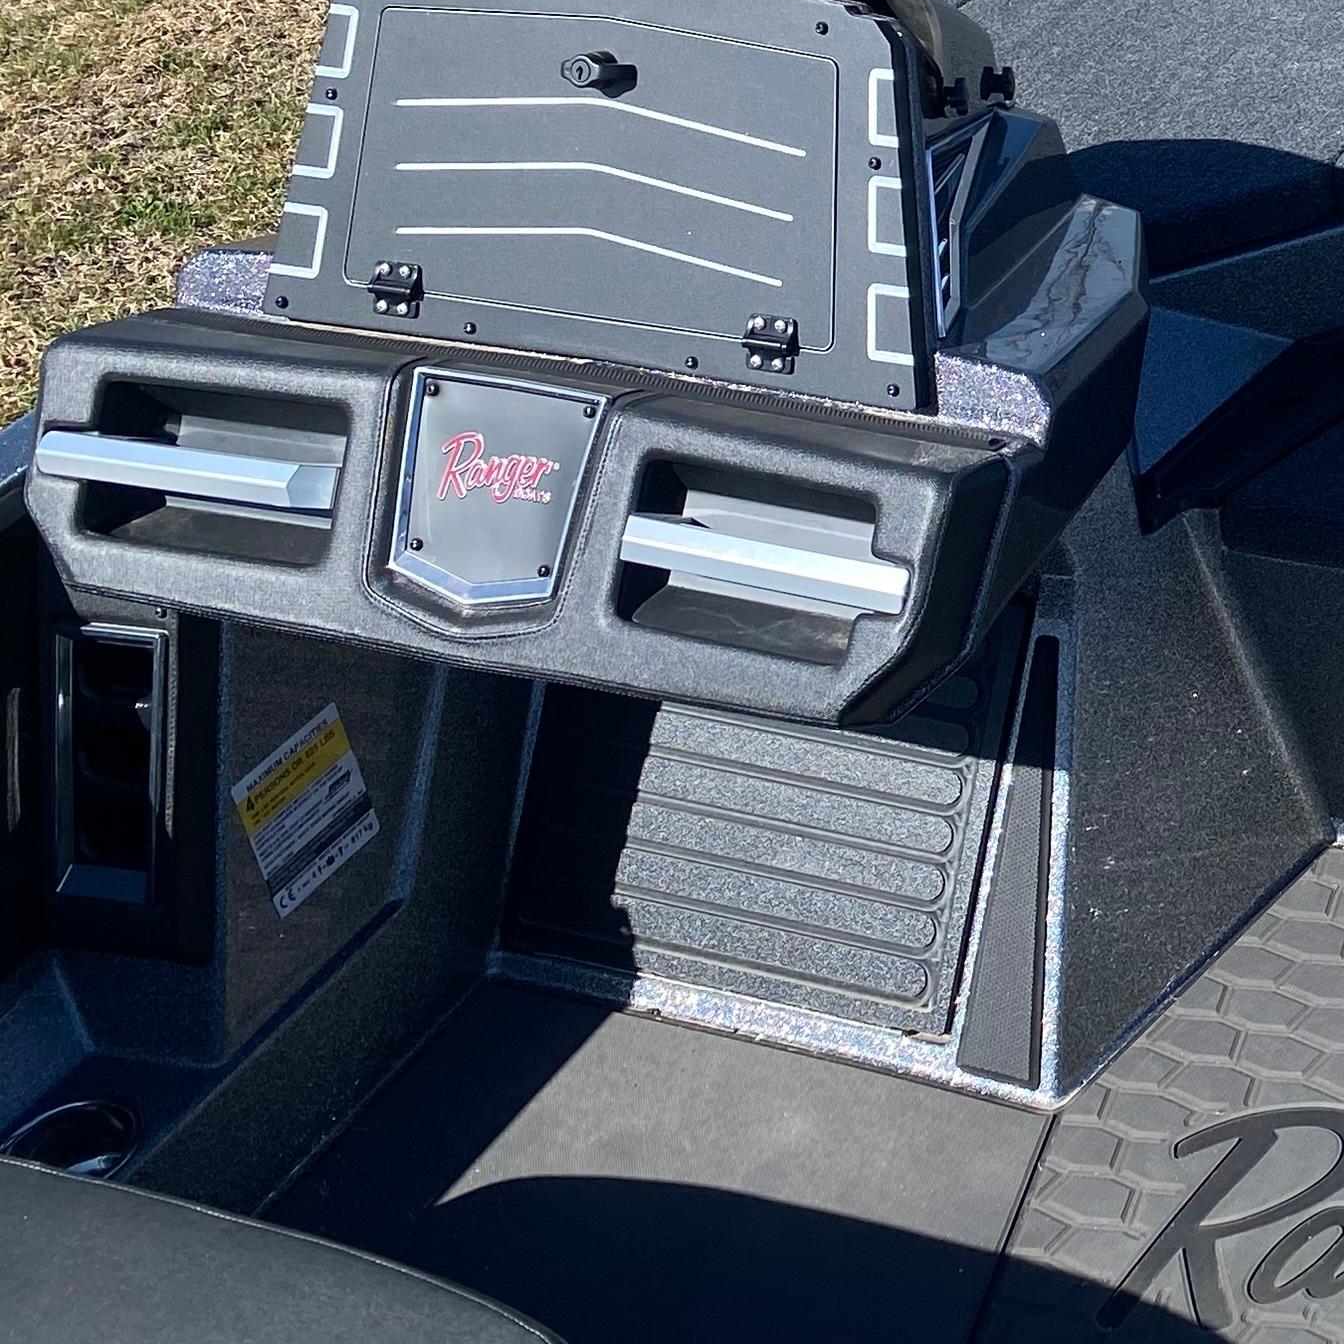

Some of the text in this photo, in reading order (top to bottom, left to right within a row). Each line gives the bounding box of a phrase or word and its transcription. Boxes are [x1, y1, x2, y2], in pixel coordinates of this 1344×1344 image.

[437, 432, 553, 503] Ranger
[246, 757, 283, 792] MAXIMUM
[283, 719, 328, 761] CAPACITIES
[246, 793, 255, 812] 4
[254, 768, 291, 802] PERSONS
[291, 757, 305, 771] OR
